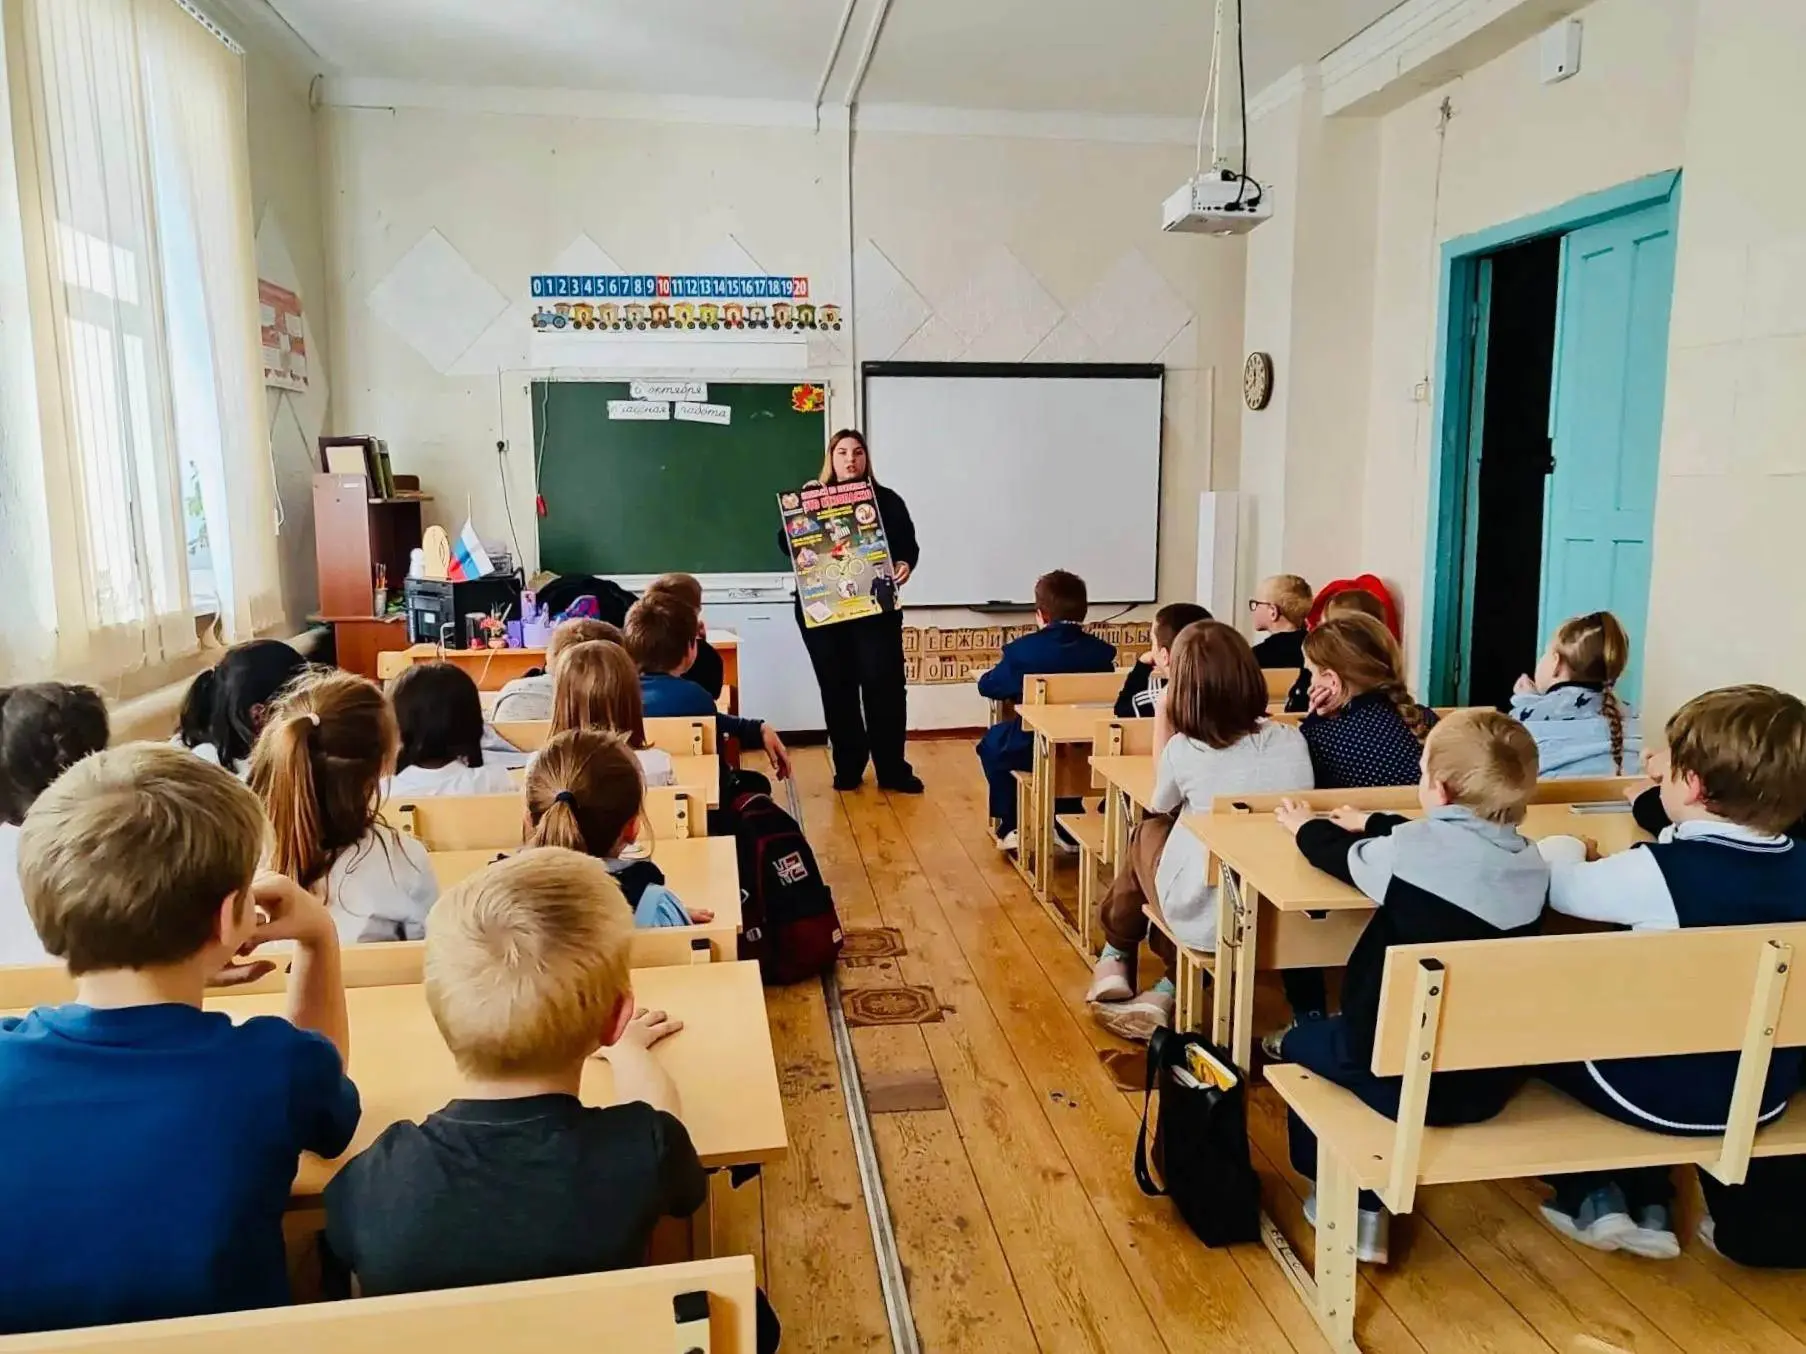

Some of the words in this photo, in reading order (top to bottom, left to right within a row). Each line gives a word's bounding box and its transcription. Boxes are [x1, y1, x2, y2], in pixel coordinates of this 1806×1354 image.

[533, 279, 541, 294] 0
[546, 279, 553, 294] 1
[559, 279, 567, 294] 2
[572, 279, 580, 294] 3
[584, 279, 592, 294] 4
[597, 279, 605, 294] 5
[609, 279, 617, 294] 6
[622, 279, 630, 294] 7
[634, 279, 642, 294] 8
[646, 279, 654, 294] 9
[658, 279, 670, 294] 10
[672, 280, 683, 294] 11
[686, 280, 698, 294] 12
[700, 280, 711, 294] 13
[712, 280, 725, 294] 14
[726, 280, 738, 295] 15
[740, 280, 752, 295] 16
[754, 280, 766, 295] 17
[768, 280, 780, 295] 18
[781, 280, 793, 296] 19
[794, 280, 806, 296] 20
[959, 634, 970, 647] Ж
[976, 634, 984, 647] З
[1139, 630, 1150, 643] Ы
[929, 665, 938, 678] О
[944, 664, 954, 678] П
[960, 664, 969, 678] Р
